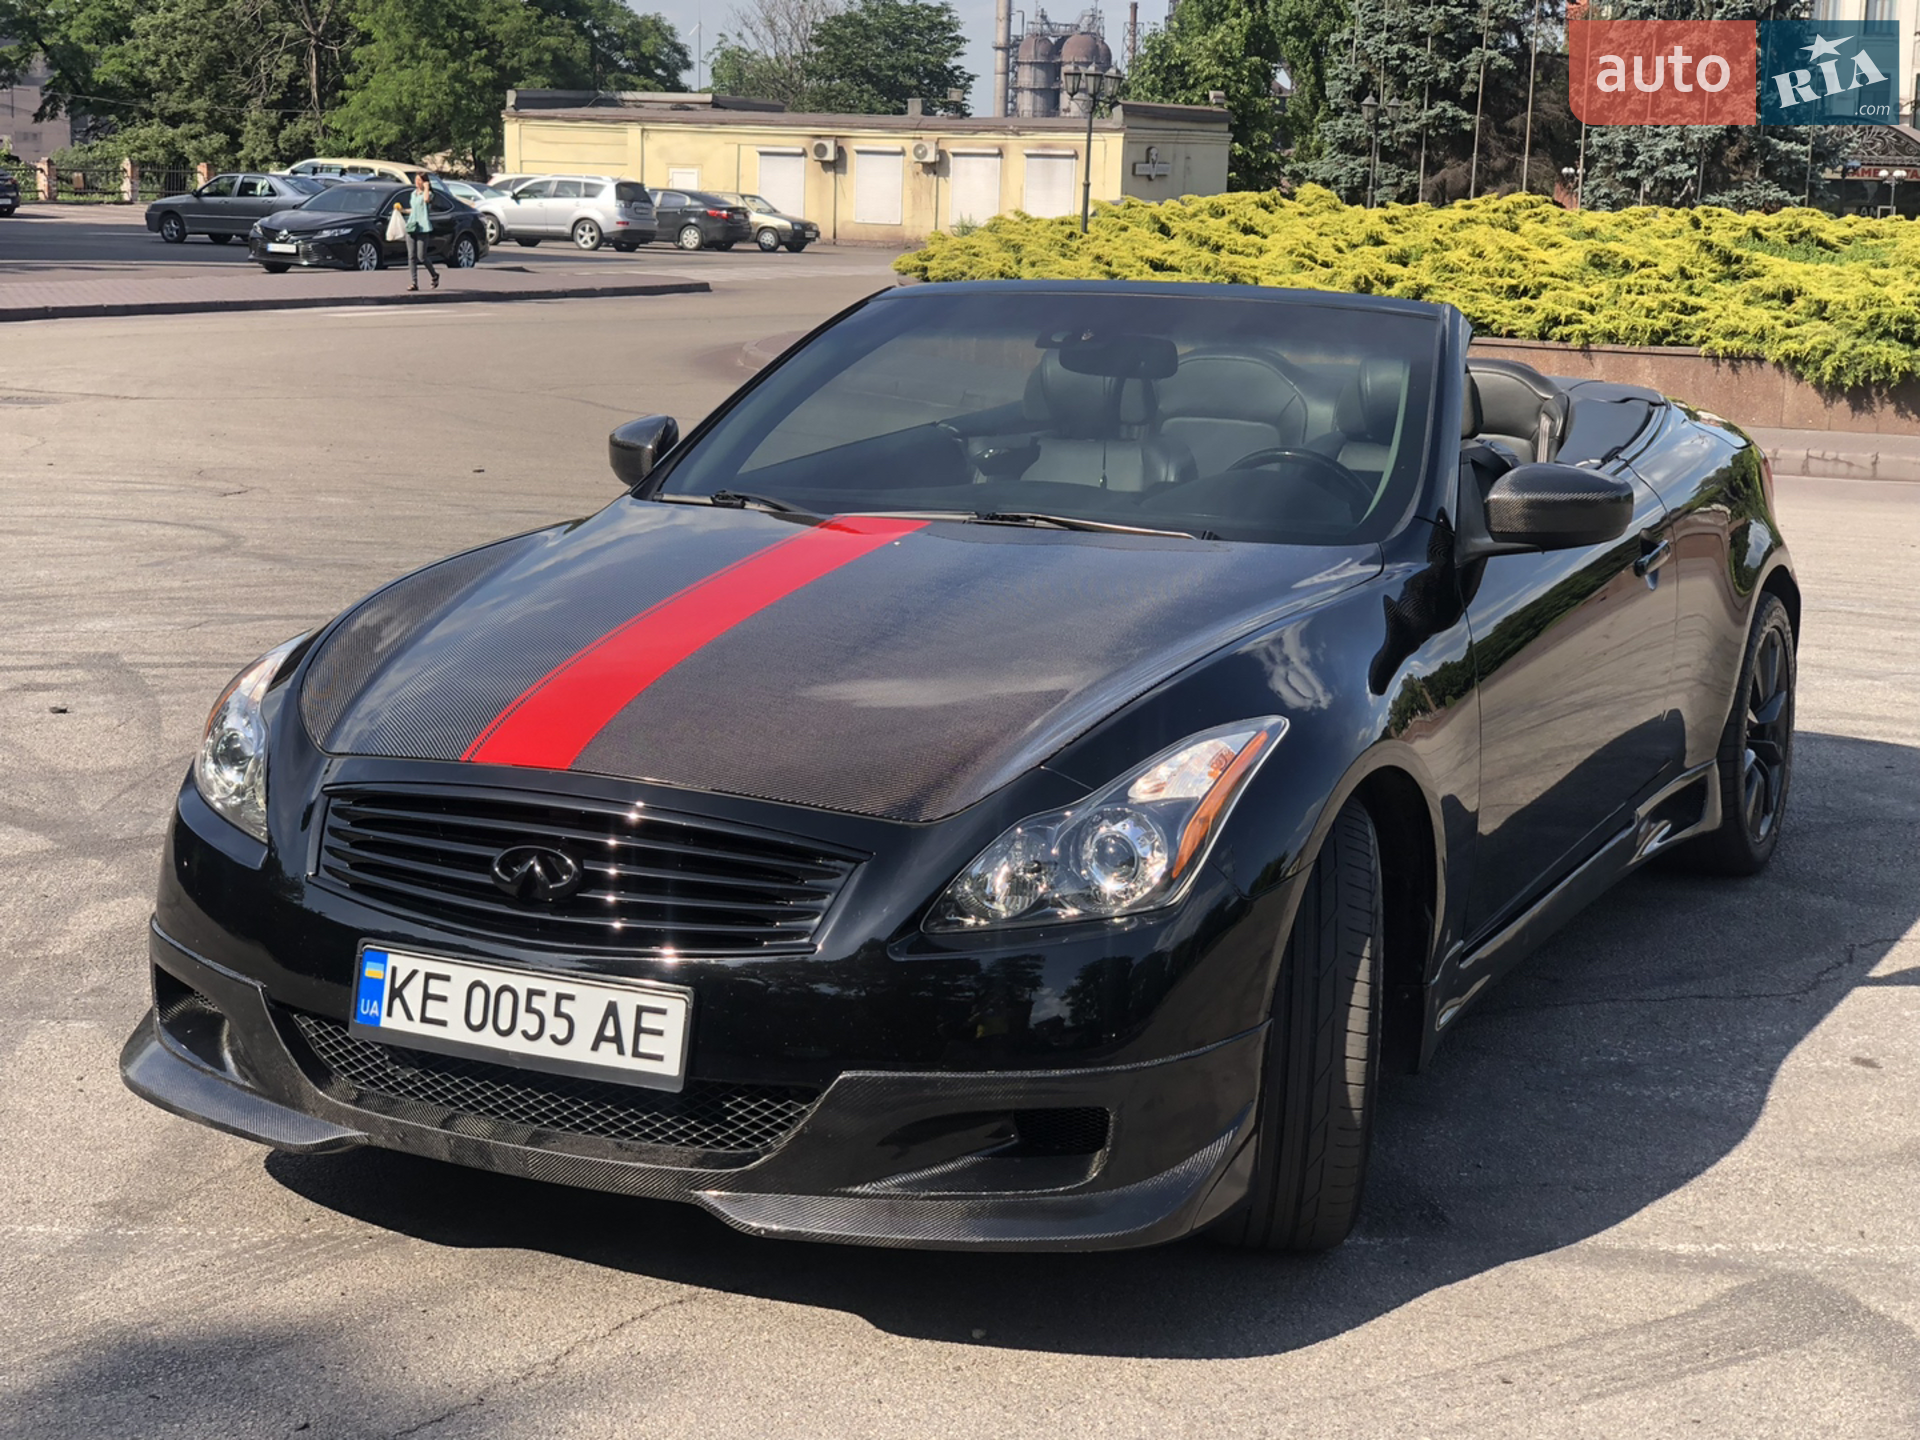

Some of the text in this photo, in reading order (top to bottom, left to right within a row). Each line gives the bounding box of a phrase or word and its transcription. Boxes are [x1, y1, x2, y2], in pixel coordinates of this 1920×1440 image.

[360, 998, 380, 1018] UA
[386, 965, 668, 1062] KE 0055 AE
